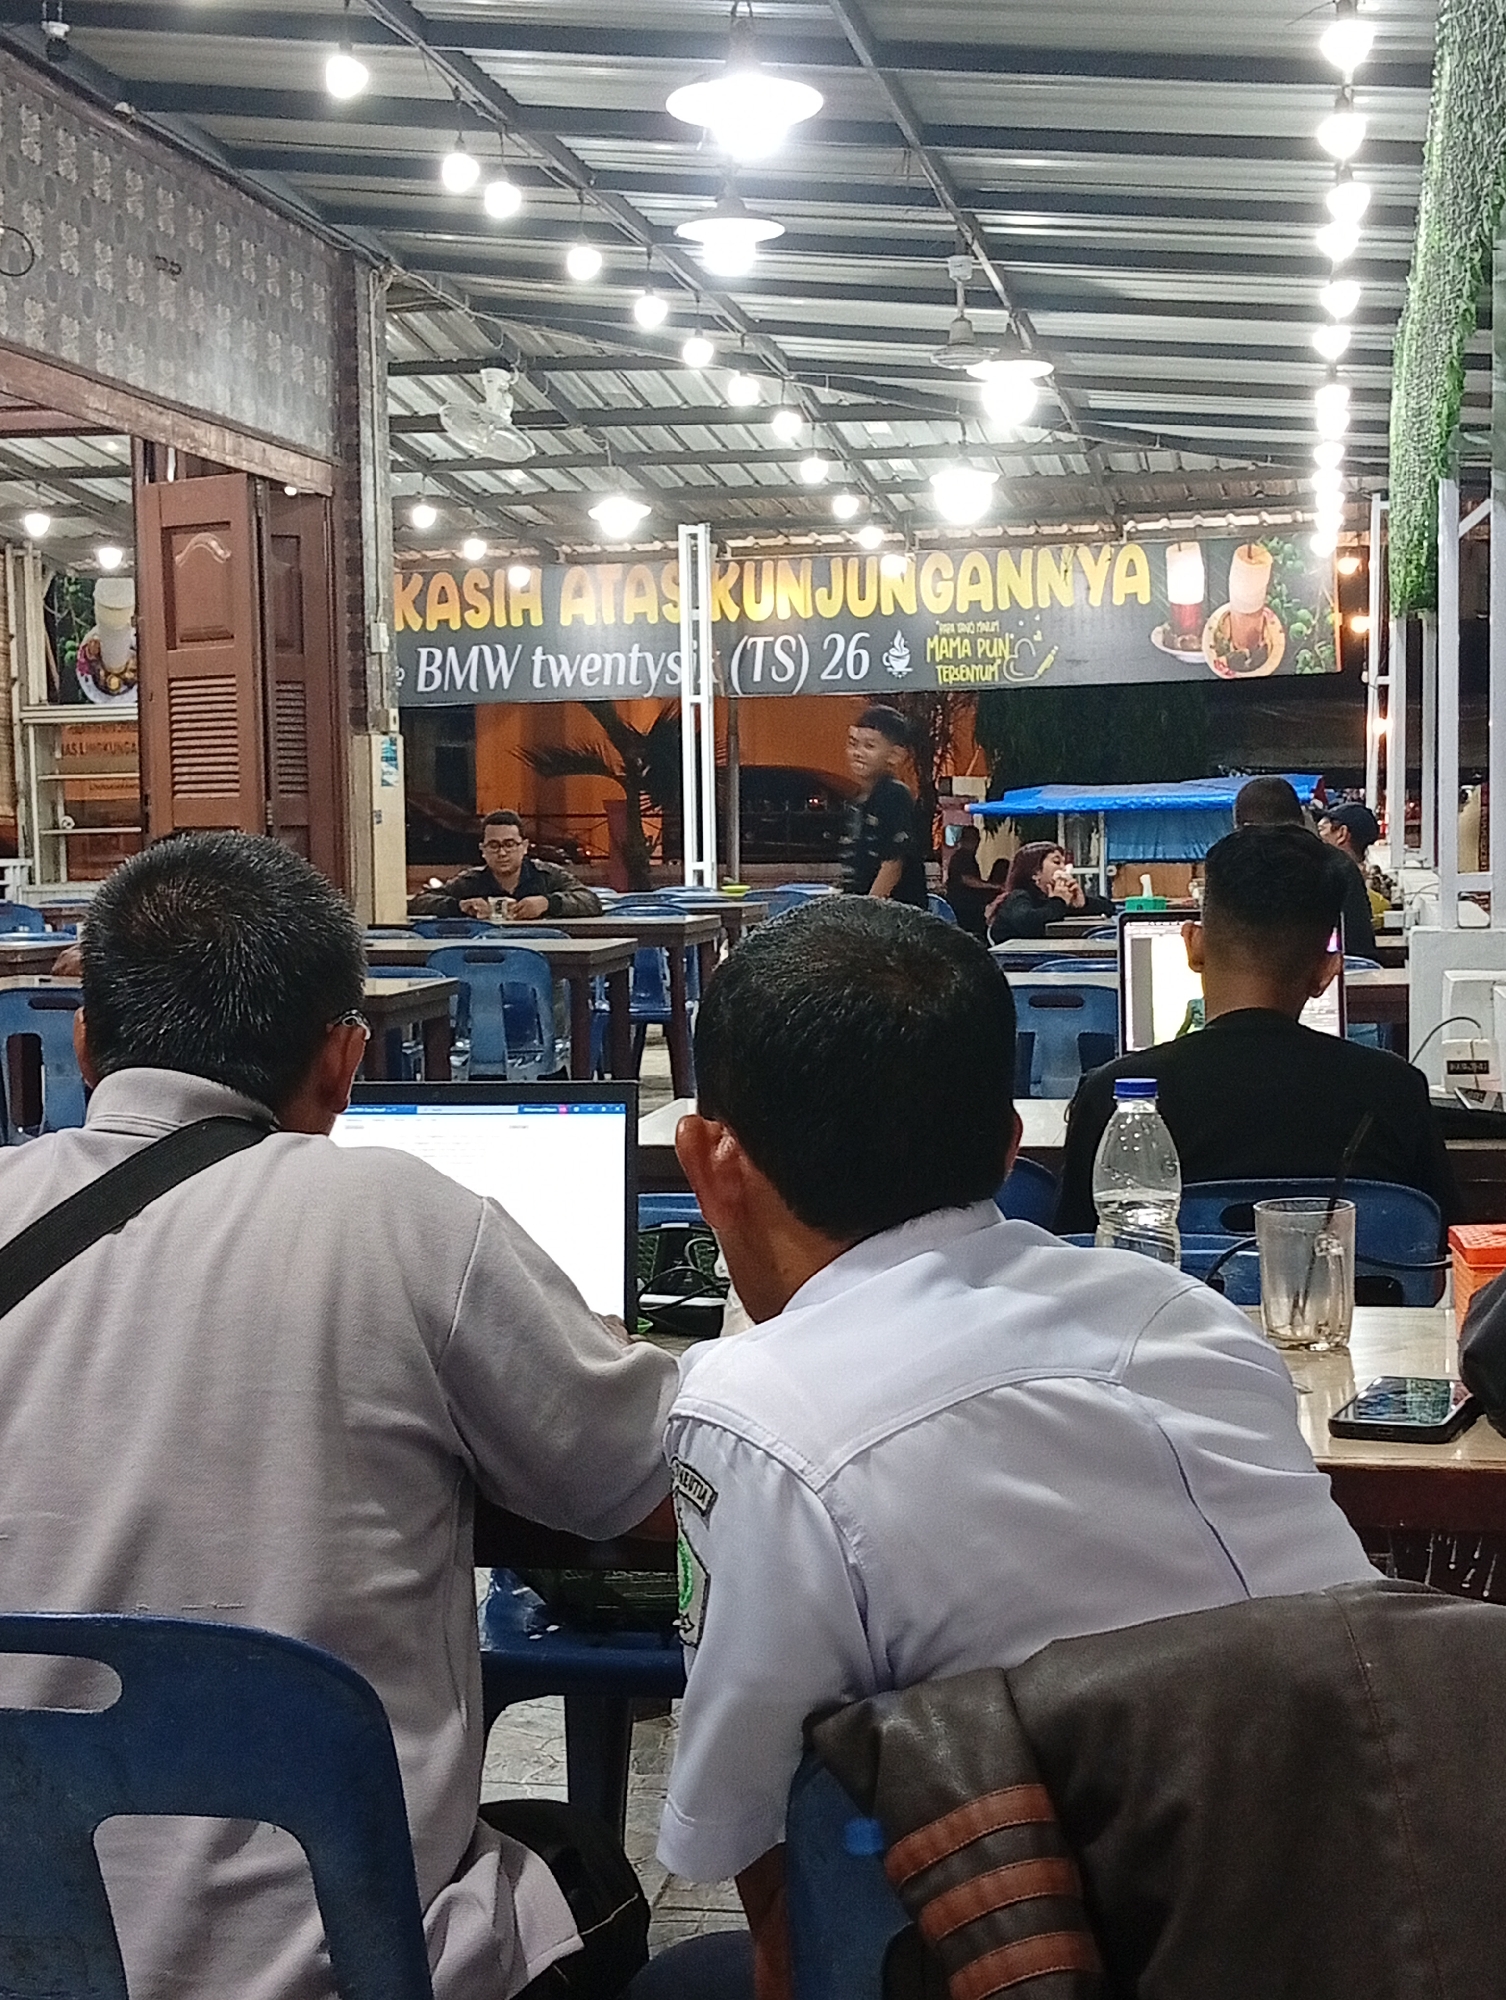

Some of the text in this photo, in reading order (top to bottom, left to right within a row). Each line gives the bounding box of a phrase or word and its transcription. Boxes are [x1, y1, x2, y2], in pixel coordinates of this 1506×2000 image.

[394, 543, 1151, 632] KASIH ATAS KUNJUNGANNYA
[417, 644, 522, 693] BMW
[731, 634, 810, 695] (TS)
[820, 631, 871, 681] 26
[926, 632, 1010, 662] MAMA PUN
[935, 661, 1000, 684] TERSENYUM
